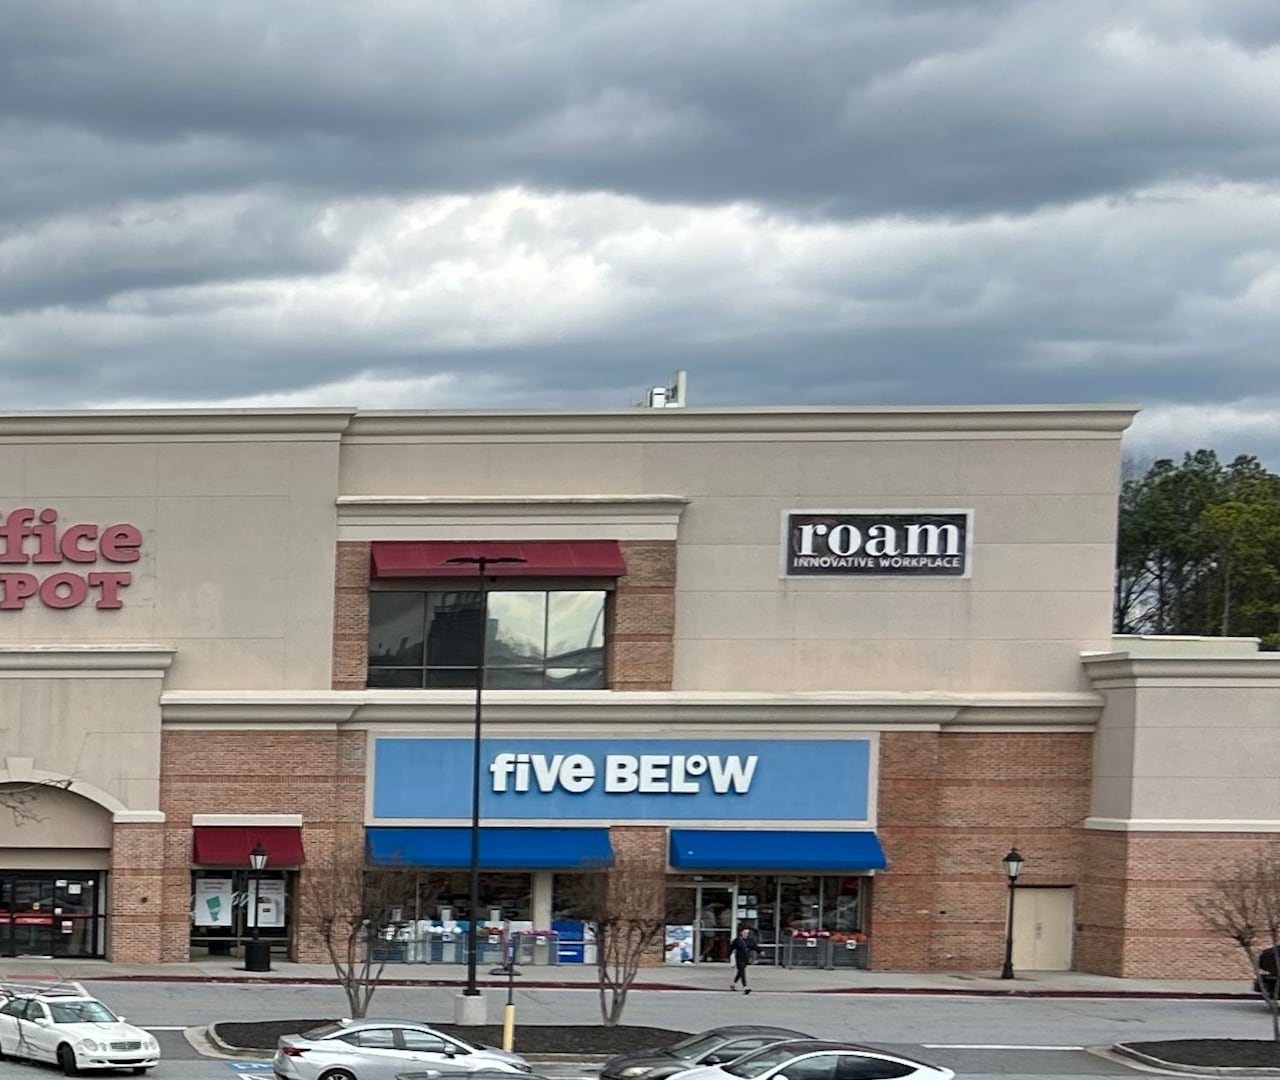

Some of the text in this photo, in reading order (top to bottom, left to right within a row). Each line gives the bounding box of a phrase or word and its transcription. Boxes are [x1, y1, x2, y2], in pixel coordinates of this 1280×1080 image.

[797, 523, 962, 557] roam
[793, 556, 961, 568] INNOVATIVE WORKPLACE
[489, 753, 759, 794] five BELOW
